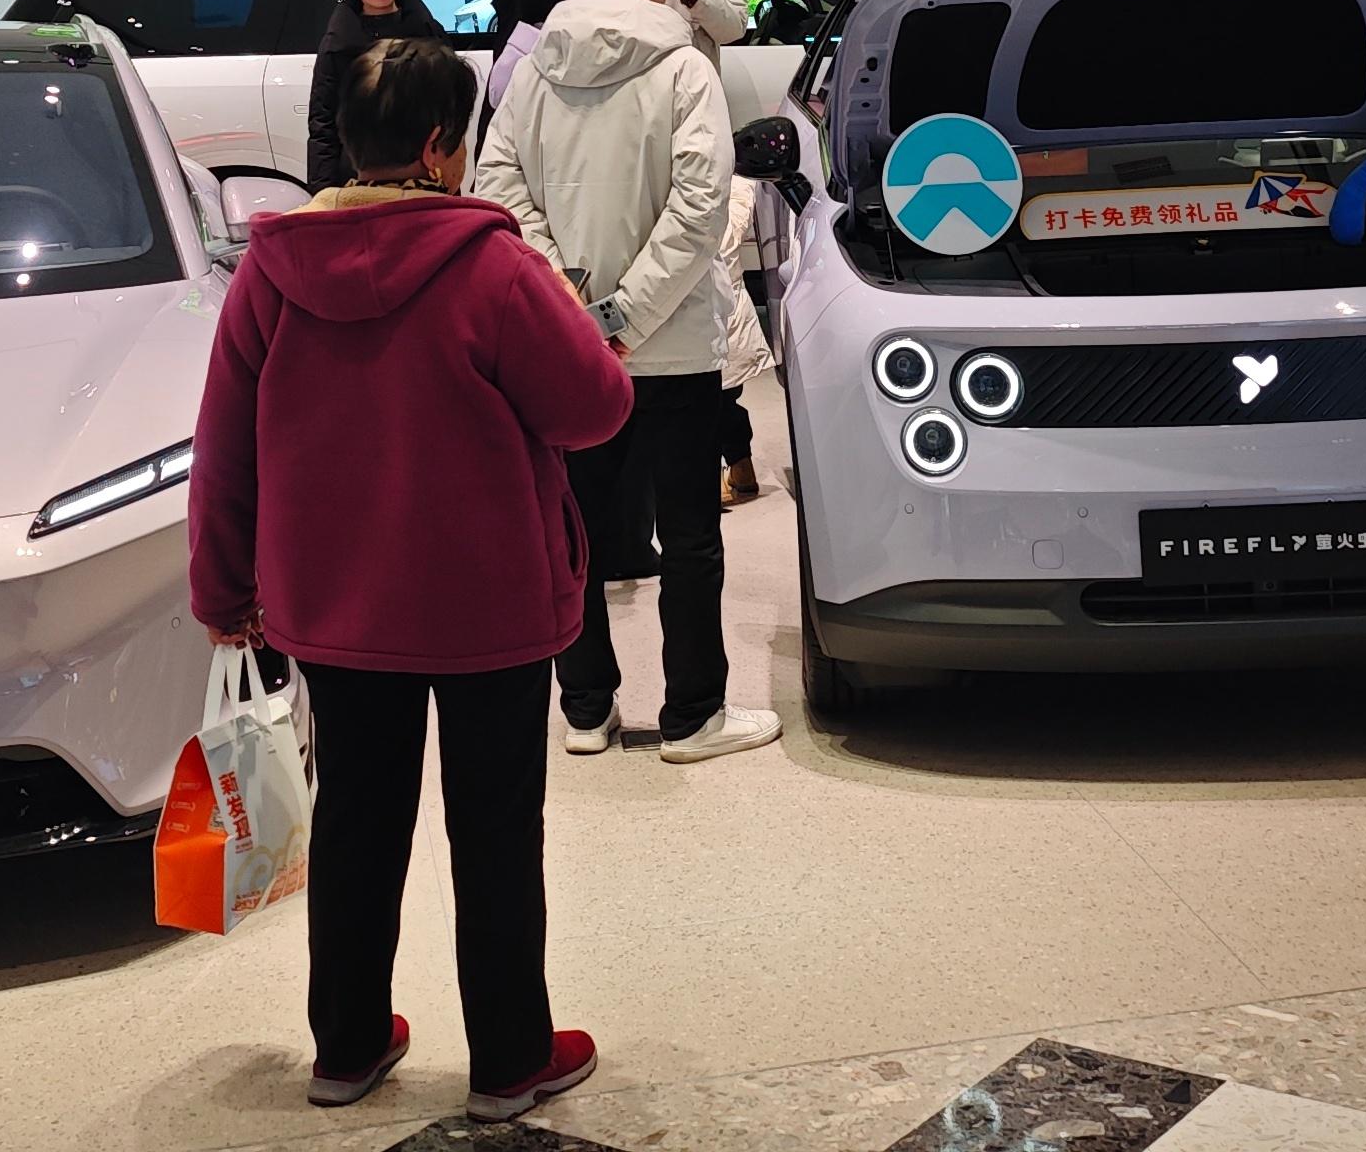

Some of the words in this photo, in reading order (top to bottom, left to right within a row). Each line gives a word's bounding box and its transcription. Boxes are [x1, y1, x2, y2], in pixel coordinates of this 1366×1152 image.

[1044, 201, 1239, 231] 打卡免费领礼品
